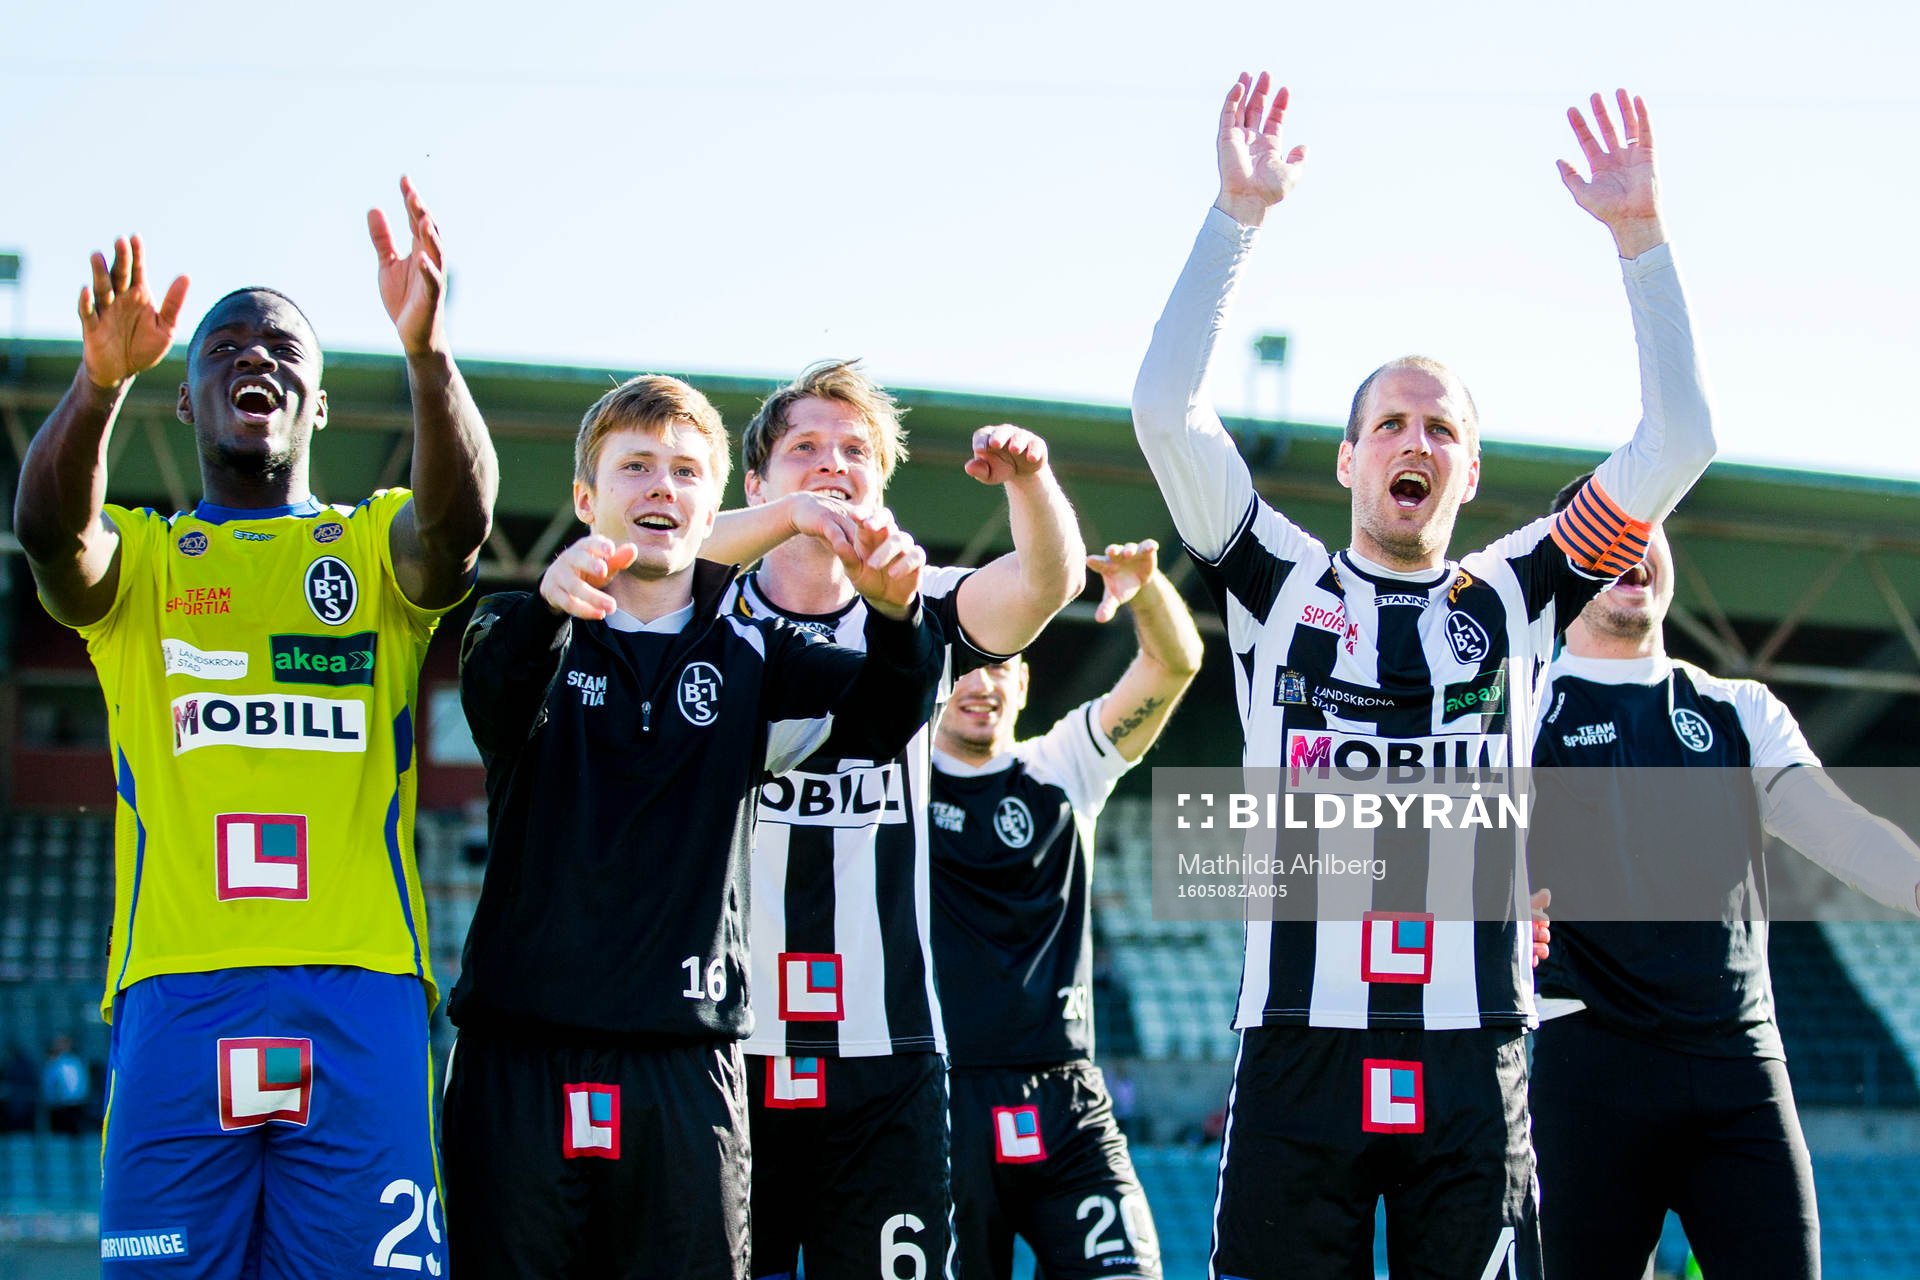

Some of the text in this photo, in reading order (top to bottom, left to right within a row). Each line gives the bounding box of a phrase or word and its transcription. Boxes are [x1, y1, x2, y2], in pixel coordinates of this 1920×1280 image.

[185, 587, 231, 602] TEAM
[179, 648, 246, 667] LANDSKRONA
[275, 647, 347, 673] akea
[1312, 696, 1338, 714] STAD
[1315, 685, 1395, 706] LANDSKRONA
[173, 699, 359, 749] MOBILL
[1577, 721, 1615, 736] TEAM
[1563, 732, 1617, 747] SPORTIA
[1290, 735, 1503, 788] MOBILL
[758, 769, 899, 816] OBILL
[681, 955, 728, 1002] 16
[1076, 1194, 1160, 1260] 20
[880, 1213, 928, 1280] 6
